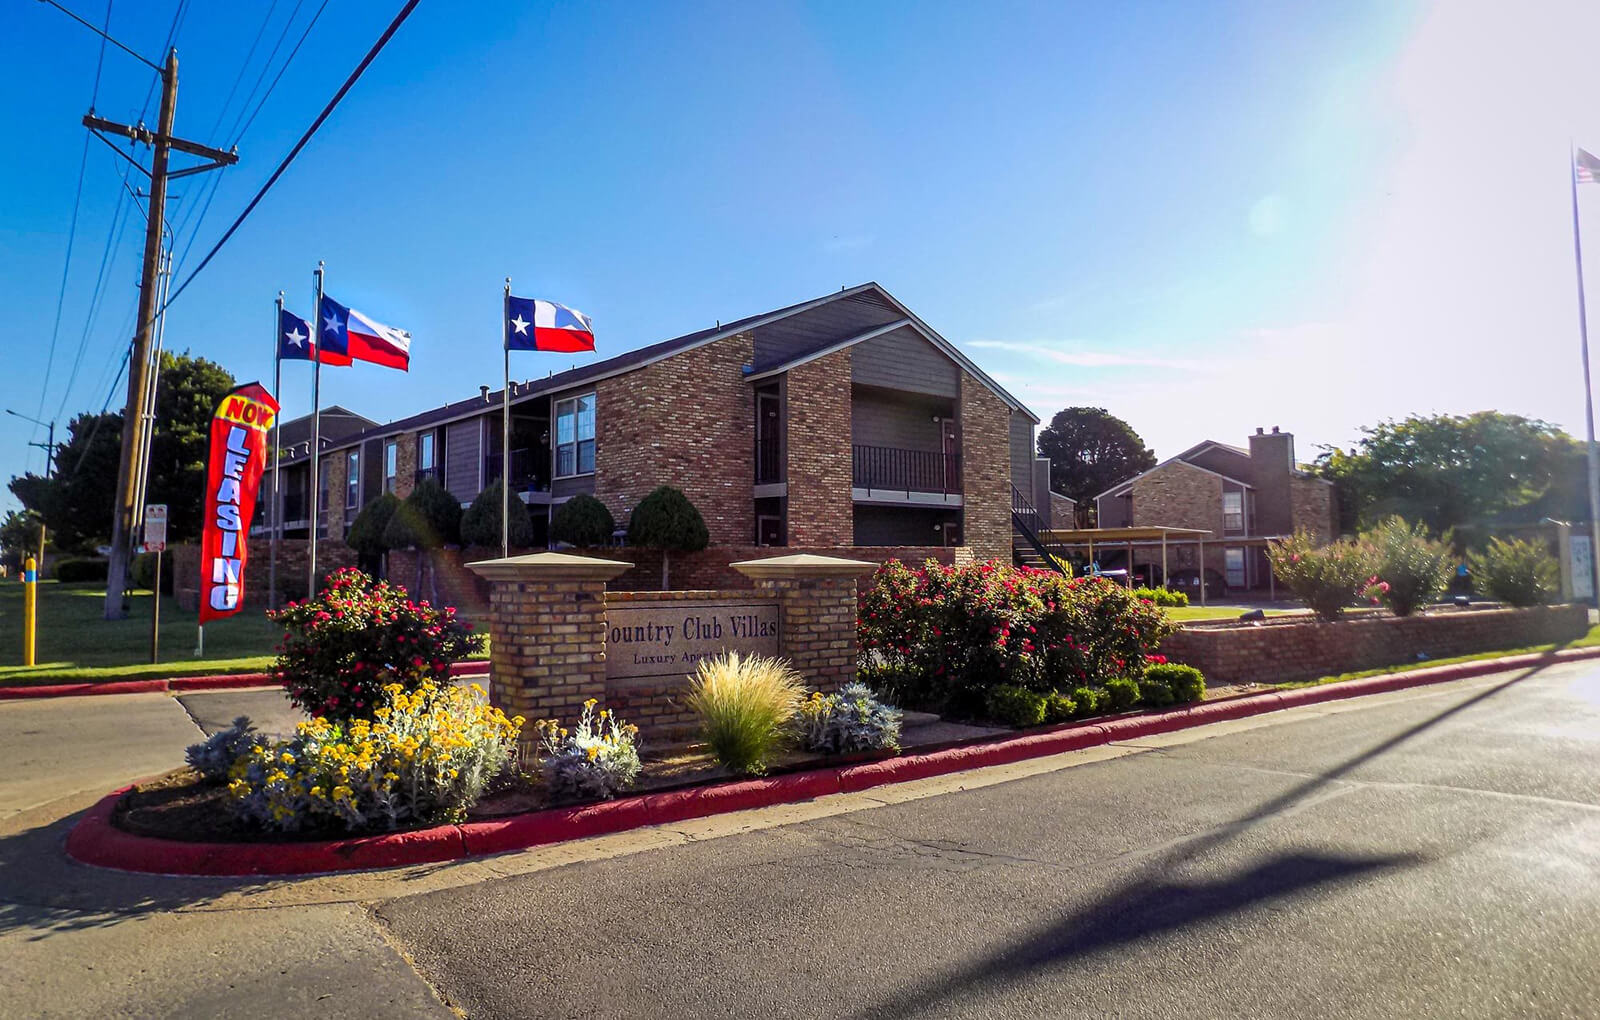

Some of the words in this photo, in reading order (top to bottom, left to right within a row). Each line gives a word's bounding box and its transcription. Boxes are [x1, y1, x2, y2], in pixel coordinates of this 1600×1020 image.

[226, 397, 273, 427] NOW
[210, 426, 250, 611] LEASING
[683, 615, 722, 640] Club
[730, 615, 776, 638] Villas
[634, 653, 676, 665] Luxury
